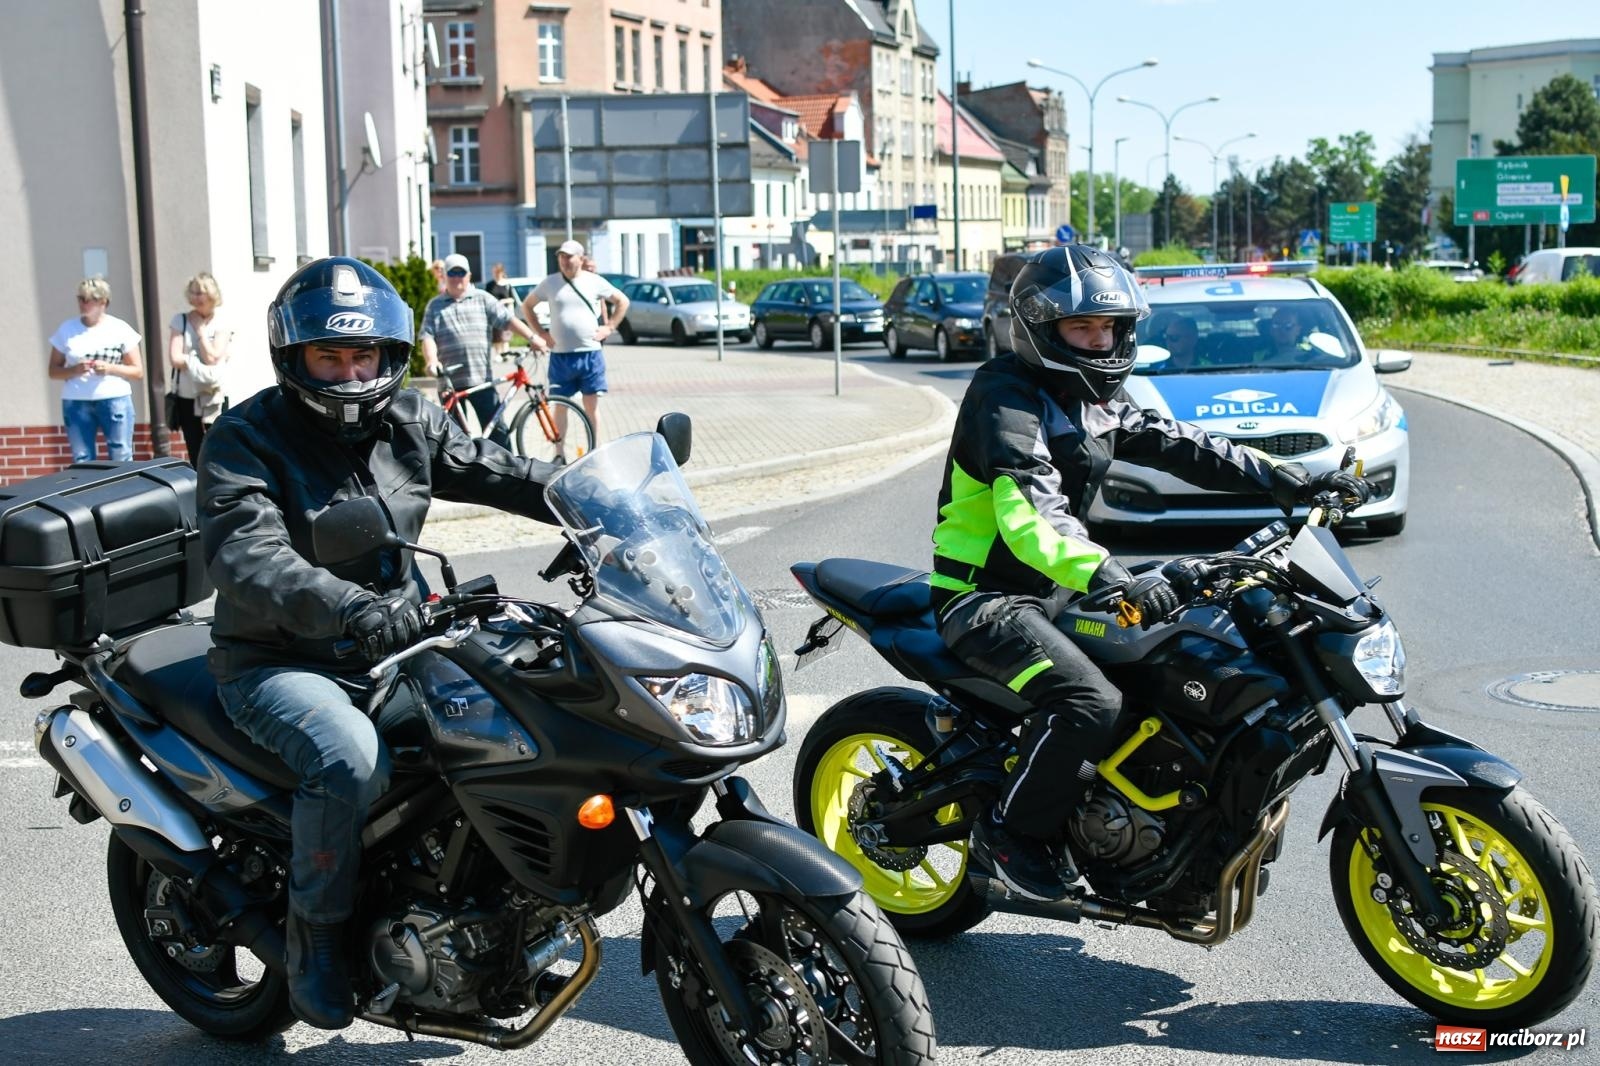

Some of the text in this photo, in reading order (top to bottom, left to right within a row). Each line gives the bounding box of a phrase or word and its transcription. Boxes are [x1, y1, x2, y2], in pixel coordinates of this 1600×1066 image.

[1099, 293, 1126, 302] HJ
[329, 318, 369, 329] MT
[1195, 402, 1299, 417] POLICJA
[1075, 618, 1106, 638] YAMAHA
